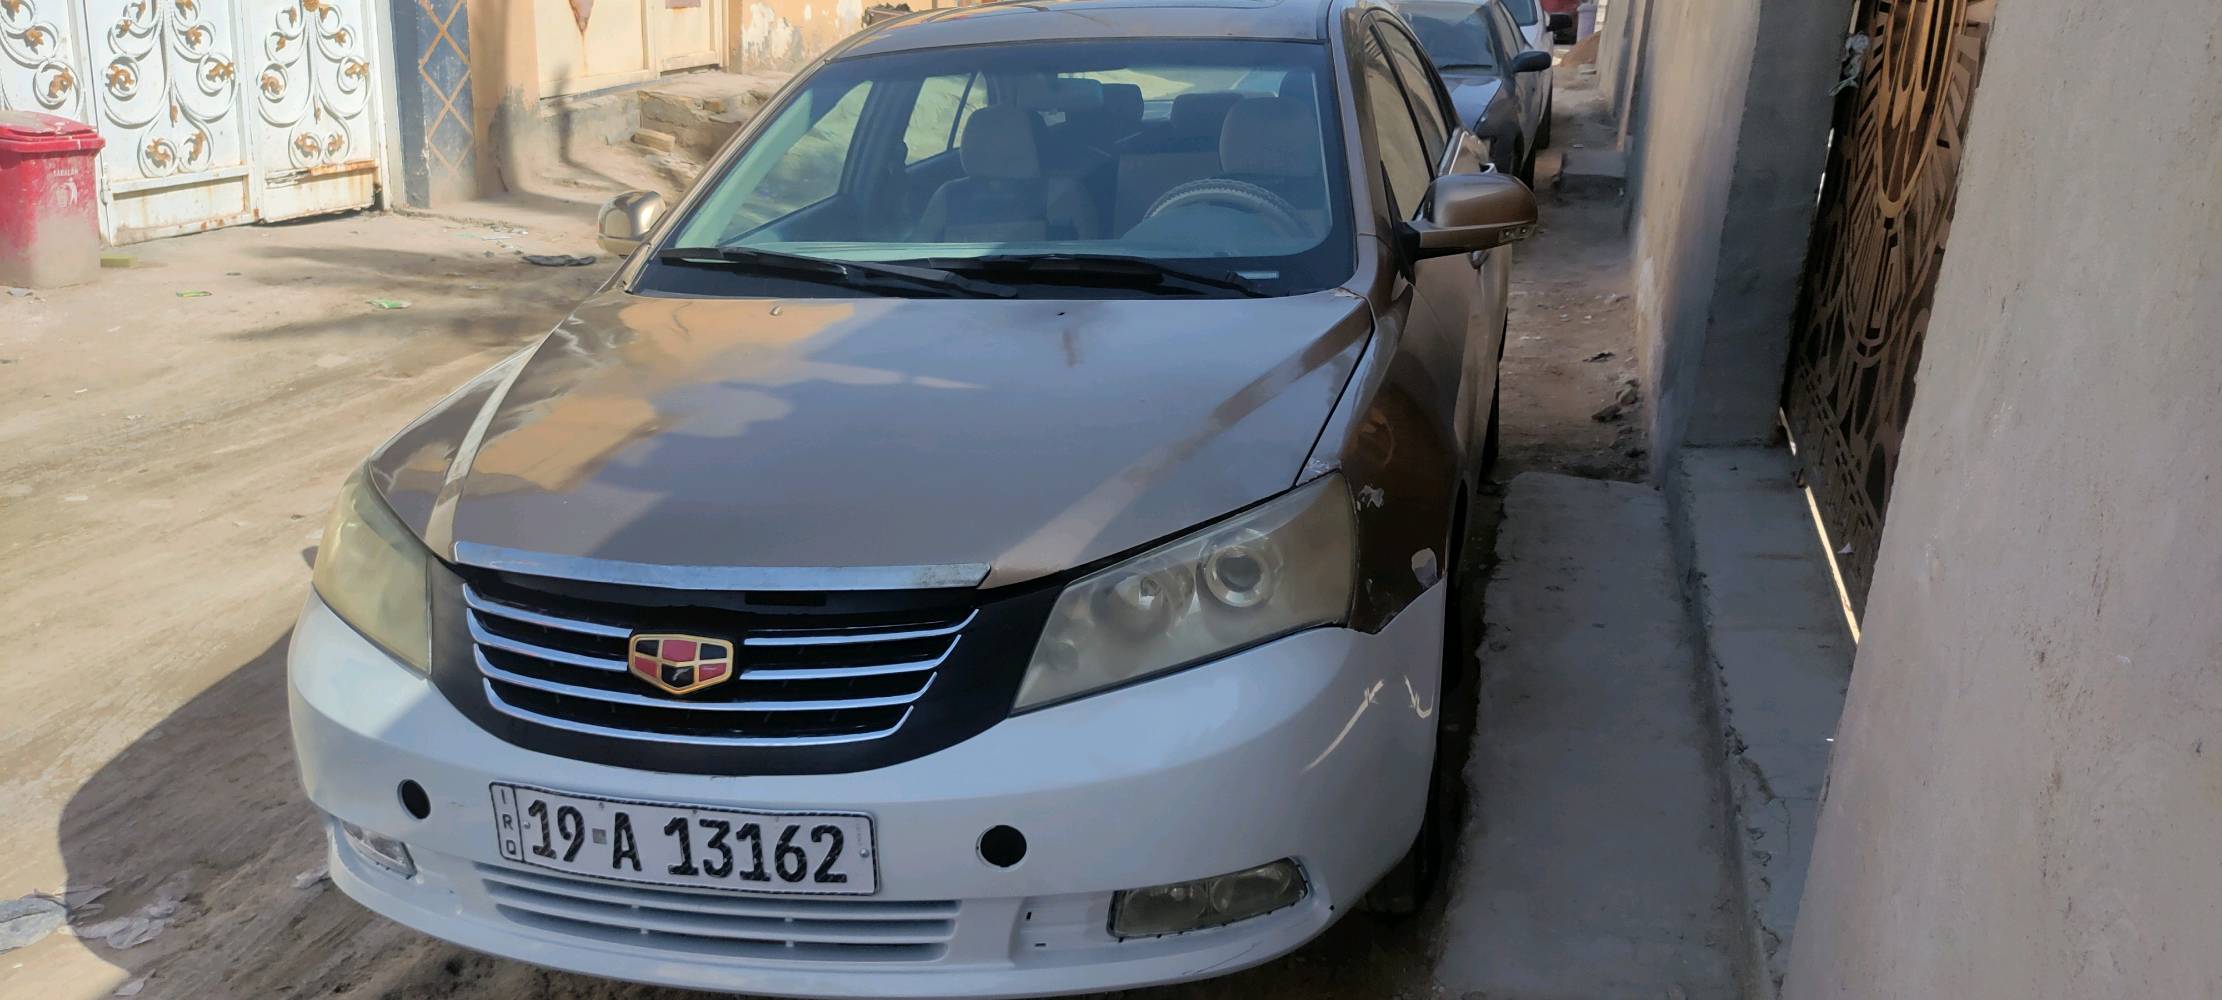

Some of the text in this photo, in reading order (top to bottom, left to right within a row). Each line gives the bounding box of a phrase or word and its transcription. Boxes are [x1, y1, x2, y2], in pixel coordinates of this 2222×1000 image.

[527, 800, 586, 862] 19
[612, 812, 643, 872] A
[664, 816, 847, 883] 13162
